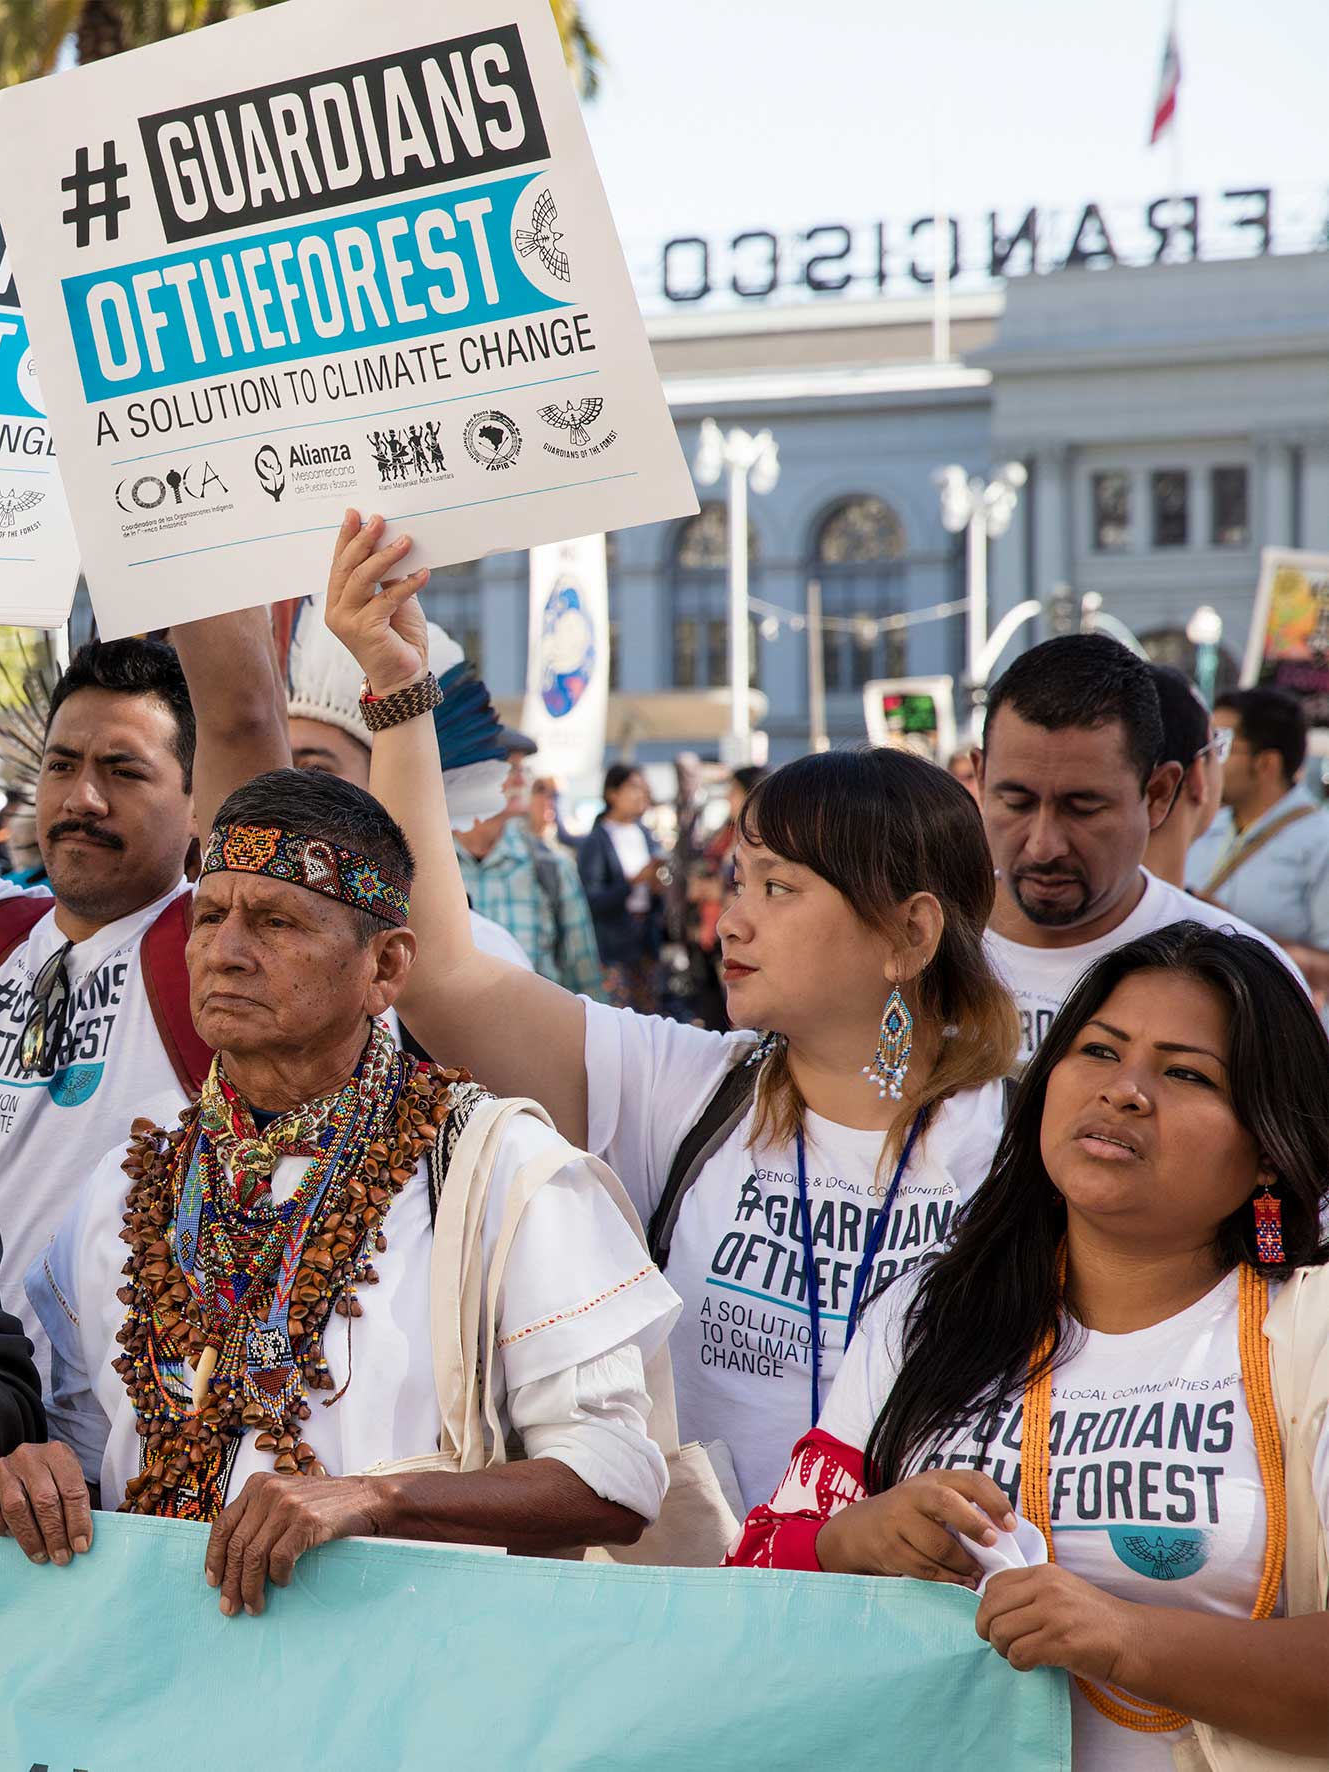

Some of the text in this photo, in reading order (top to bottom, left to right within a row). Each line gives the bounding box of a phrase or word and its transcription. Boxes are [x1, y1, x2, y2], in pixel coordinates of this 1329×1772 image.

[61, 42, 526, 248] # GUARDIANS
[85, 196, 501, 383] OFTHEFOREST
[95, 313, 597, 446] A SOLUTION TO CLIMATE CHANGE
[290, 443, 352, 468] Alianza
[543, 442, 580, 459] GUARDIANS
[813, 1178, 822, 1188] &
[734, 1174, 961, 1254] #GUARDIAN
[700, 1297, 712, 1317] A
[700, 1320, 728, 1343] TO
[700, 1344, 784, 1378] CHANGE
[1062, 1387, 1108, 1401] LOCAL
[1112, 1376, 1210, 1399] COMMUNITIES
[1212, 1373, 1239, 1391] ARE
